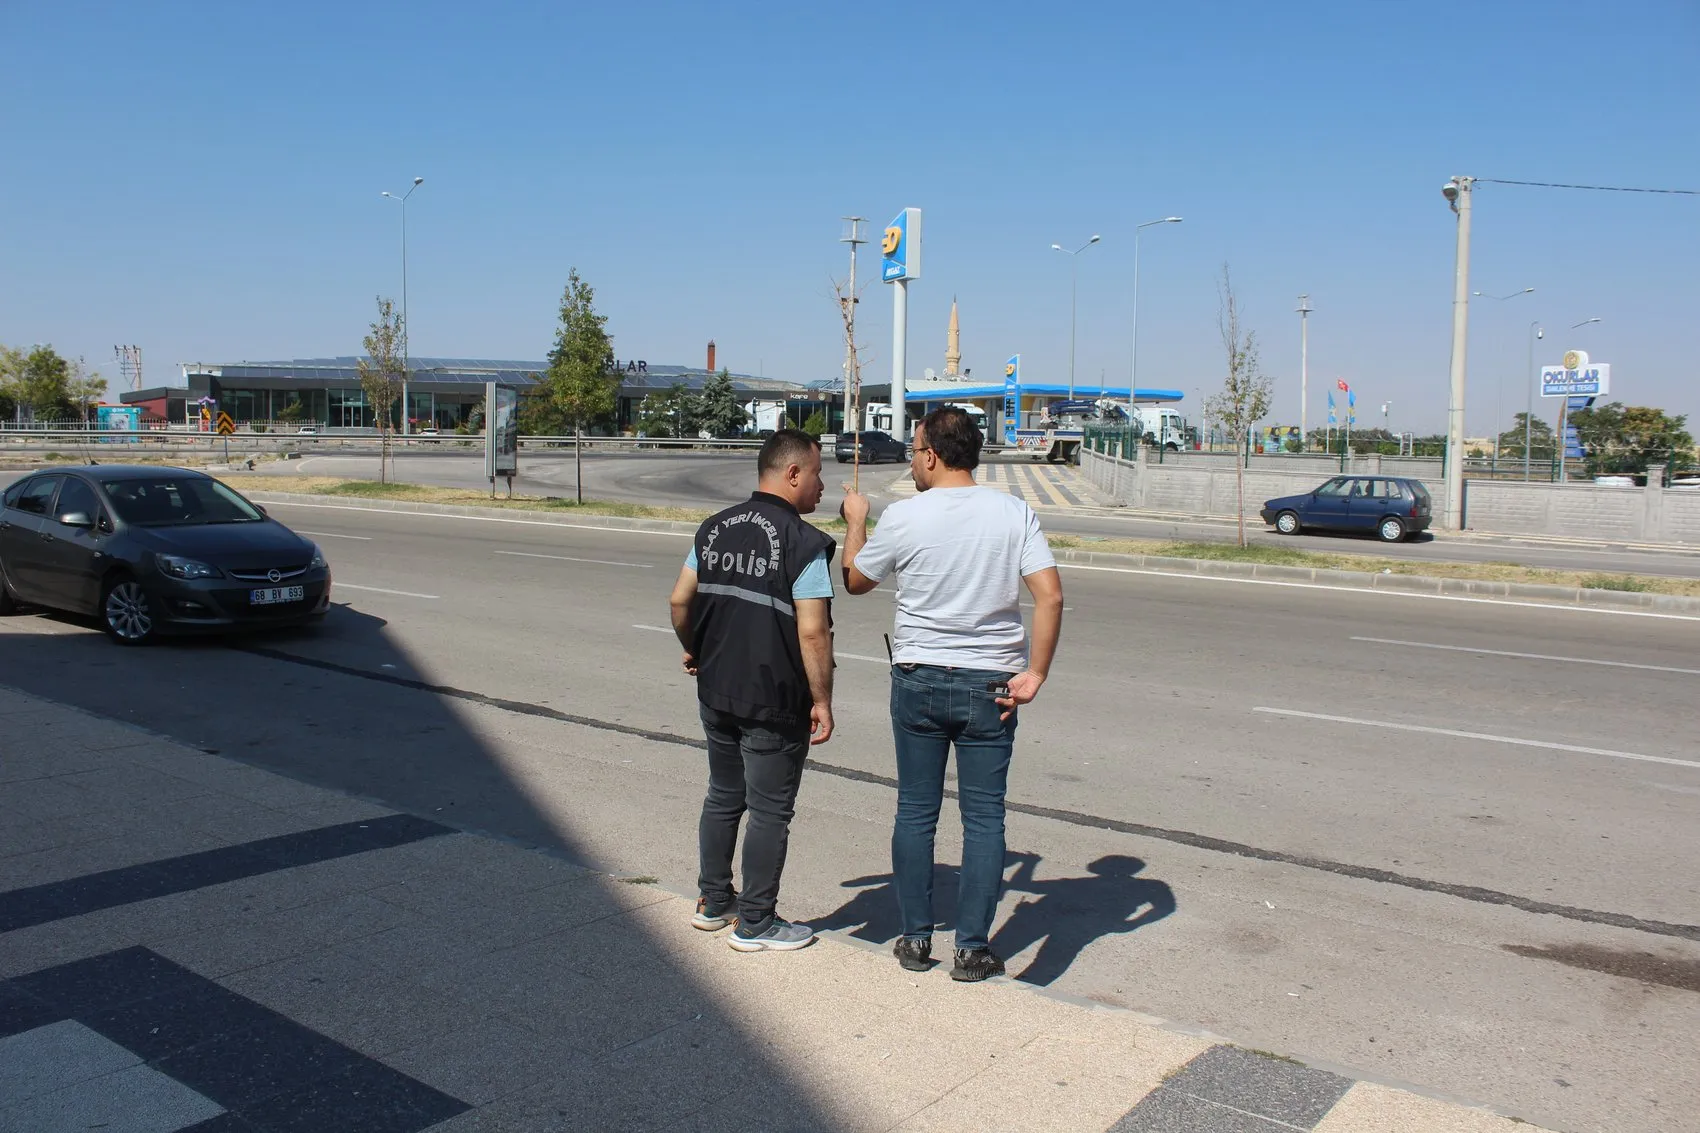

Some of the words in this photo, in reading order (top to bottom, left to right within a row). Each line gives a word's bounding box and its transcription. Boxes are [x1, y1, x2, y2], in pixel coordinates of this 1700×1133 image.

[604, 360, 647, 373] RLAR
[1543, 369, 1599, 384] OKURLAR
[701, 525, 720, 561] OLAY
[707, 549, 767, 578] POLİS
[255, 590, 265, 600] 68
[288, 587, 302, 597] 693
